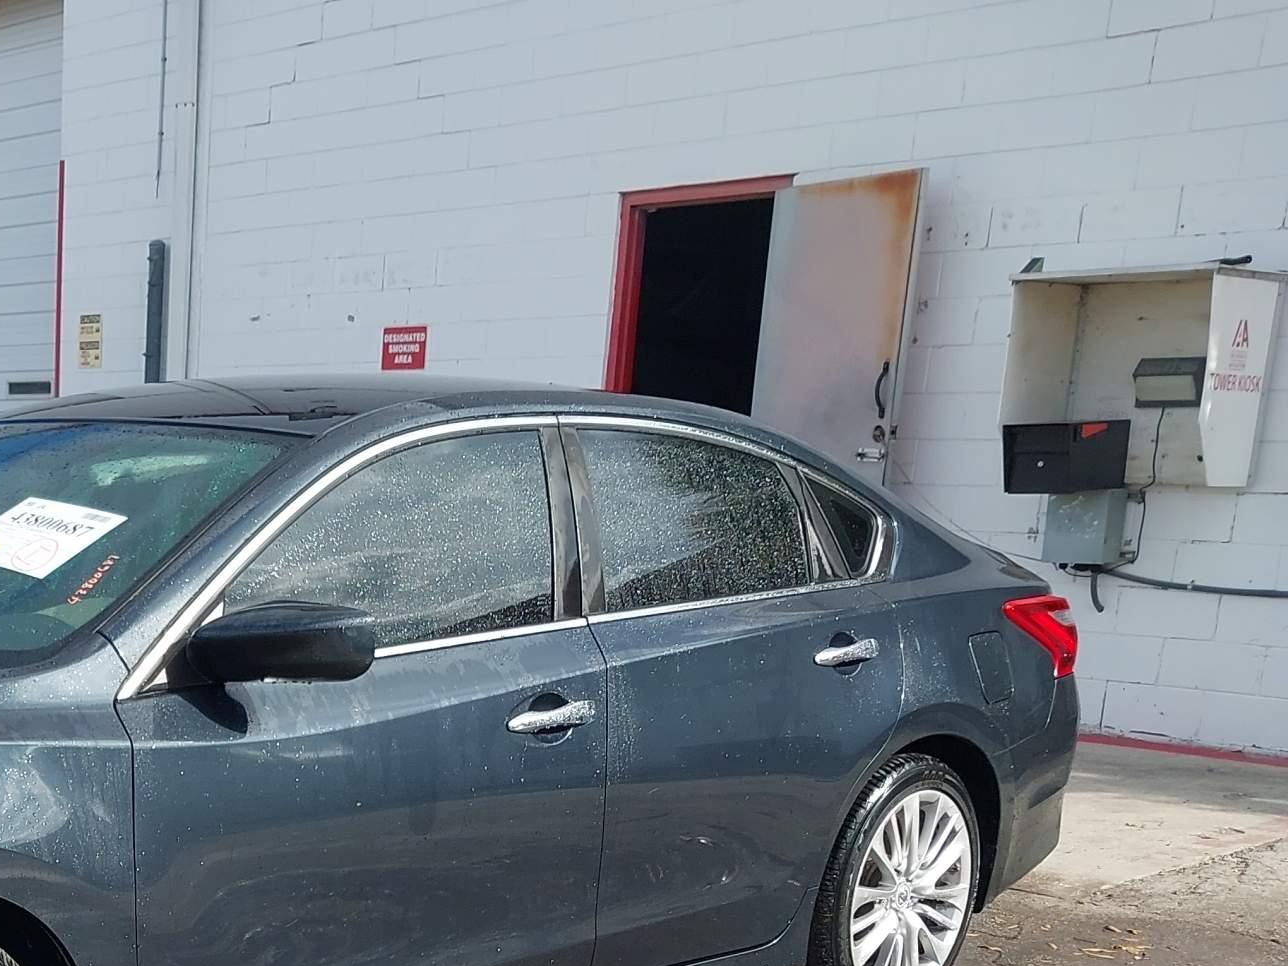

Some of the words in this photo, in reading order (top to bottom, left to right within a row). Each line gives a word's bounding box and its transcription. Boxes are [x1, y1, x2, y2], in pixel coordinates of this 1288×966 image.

[384, 333, 425, 343] DESIGNATED
[388, 343, 420, 353] SMOKING
[394, 354, 412, 364] AREA
[1209, 373, 1237, 391] TOWER
[1238, 374, 1262, 392] KIOSK
[11, 511, 95, 538] 43800687
